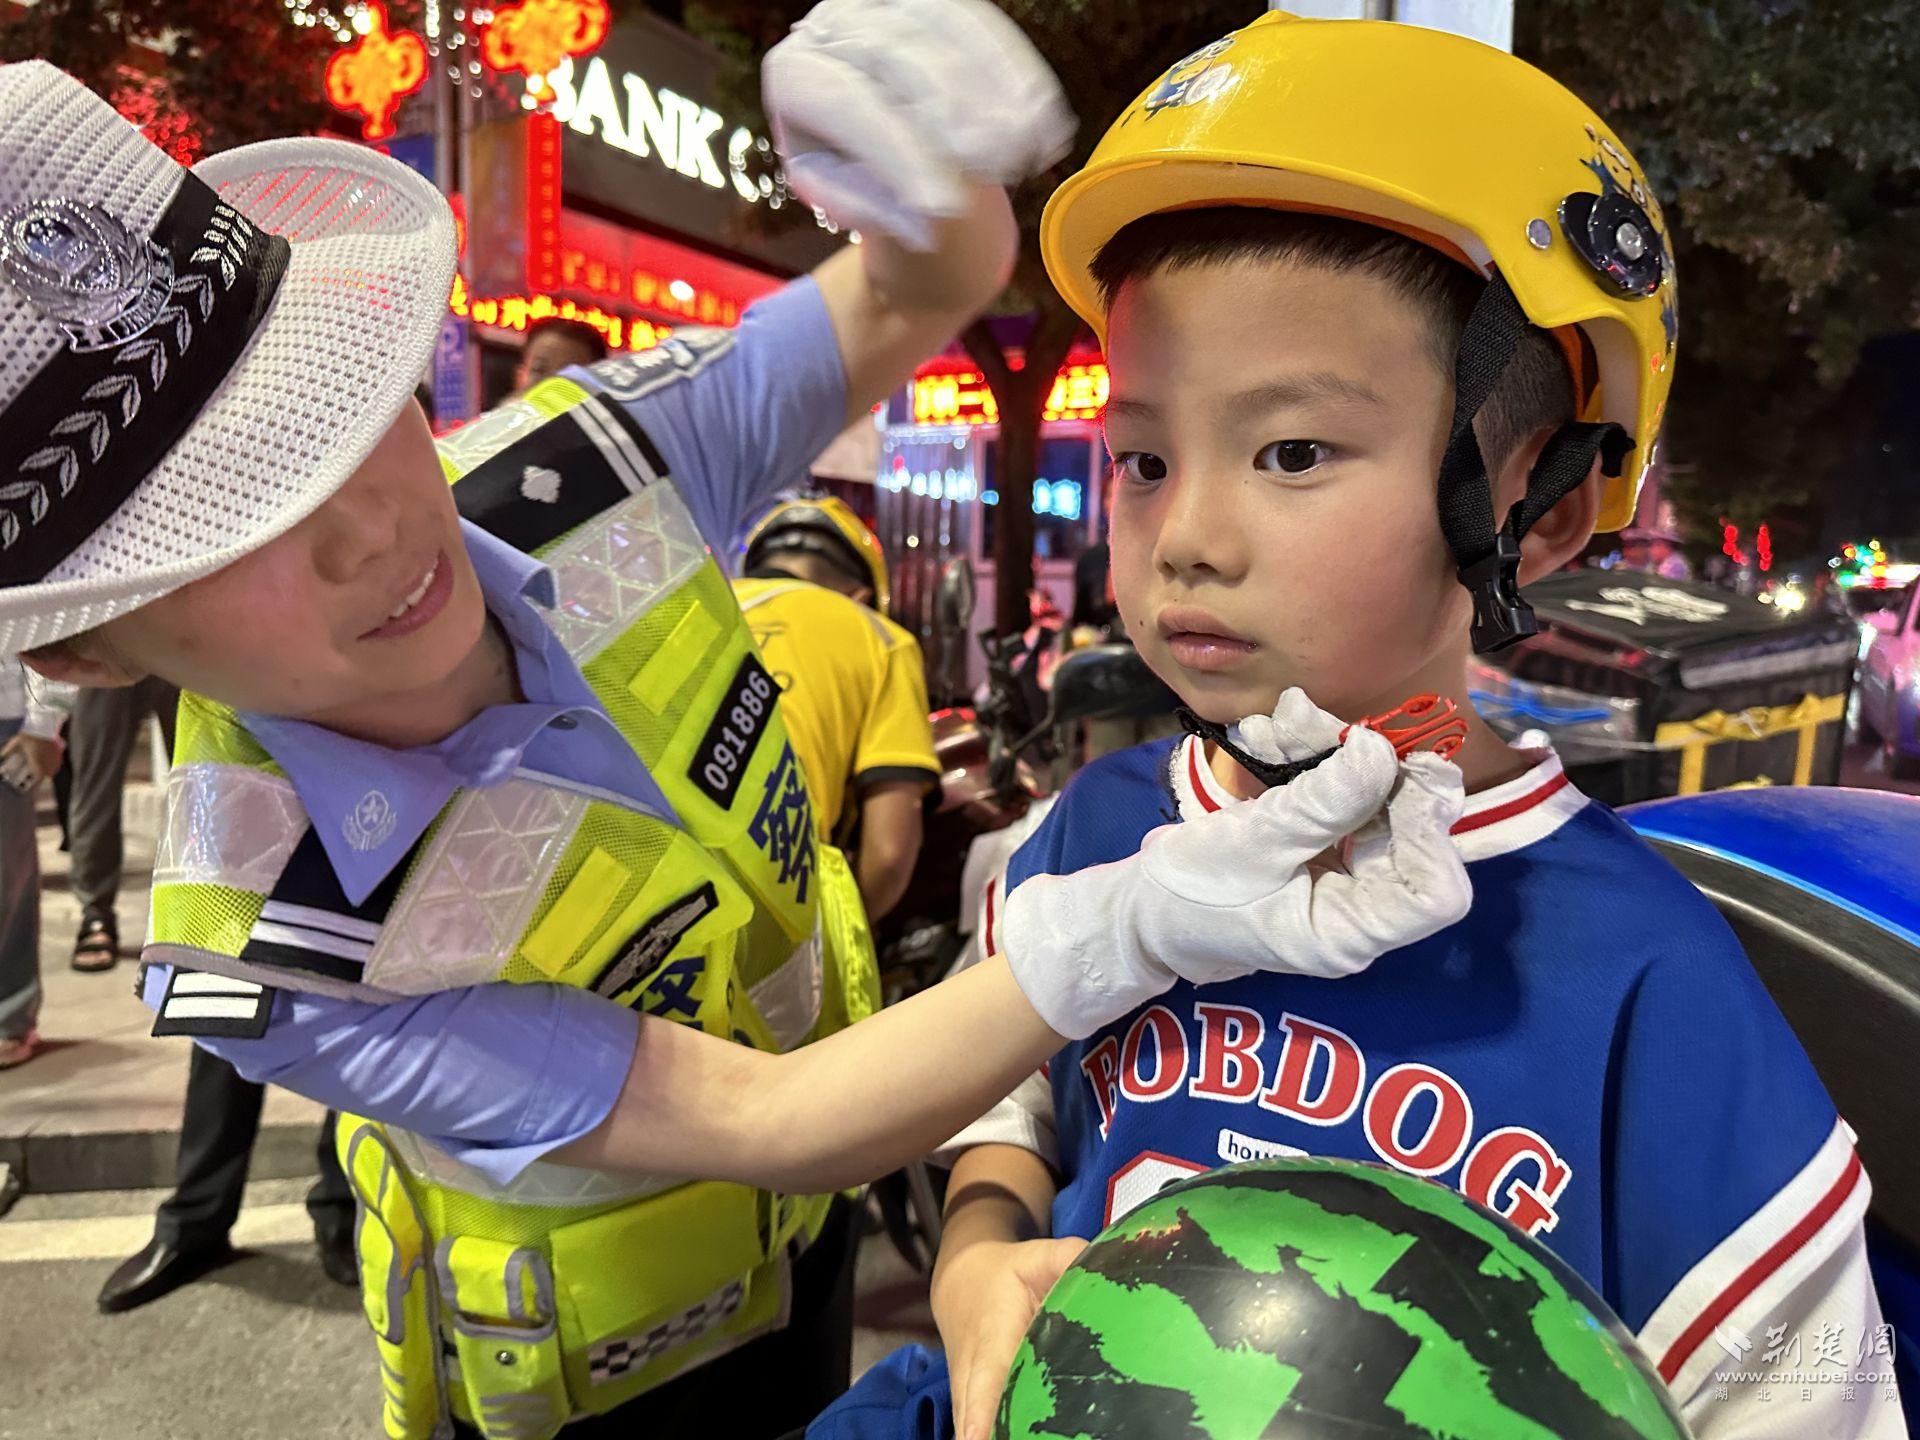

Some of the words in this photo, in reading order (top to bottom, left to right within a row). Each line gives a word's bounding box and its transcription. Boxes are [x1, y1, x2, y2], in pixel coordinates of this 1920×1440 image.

[547, 54, 726, 189] BANK
[704, 671, 770, 790] 091886
[1080, 1001, 1572, 1238] BOBDOG
